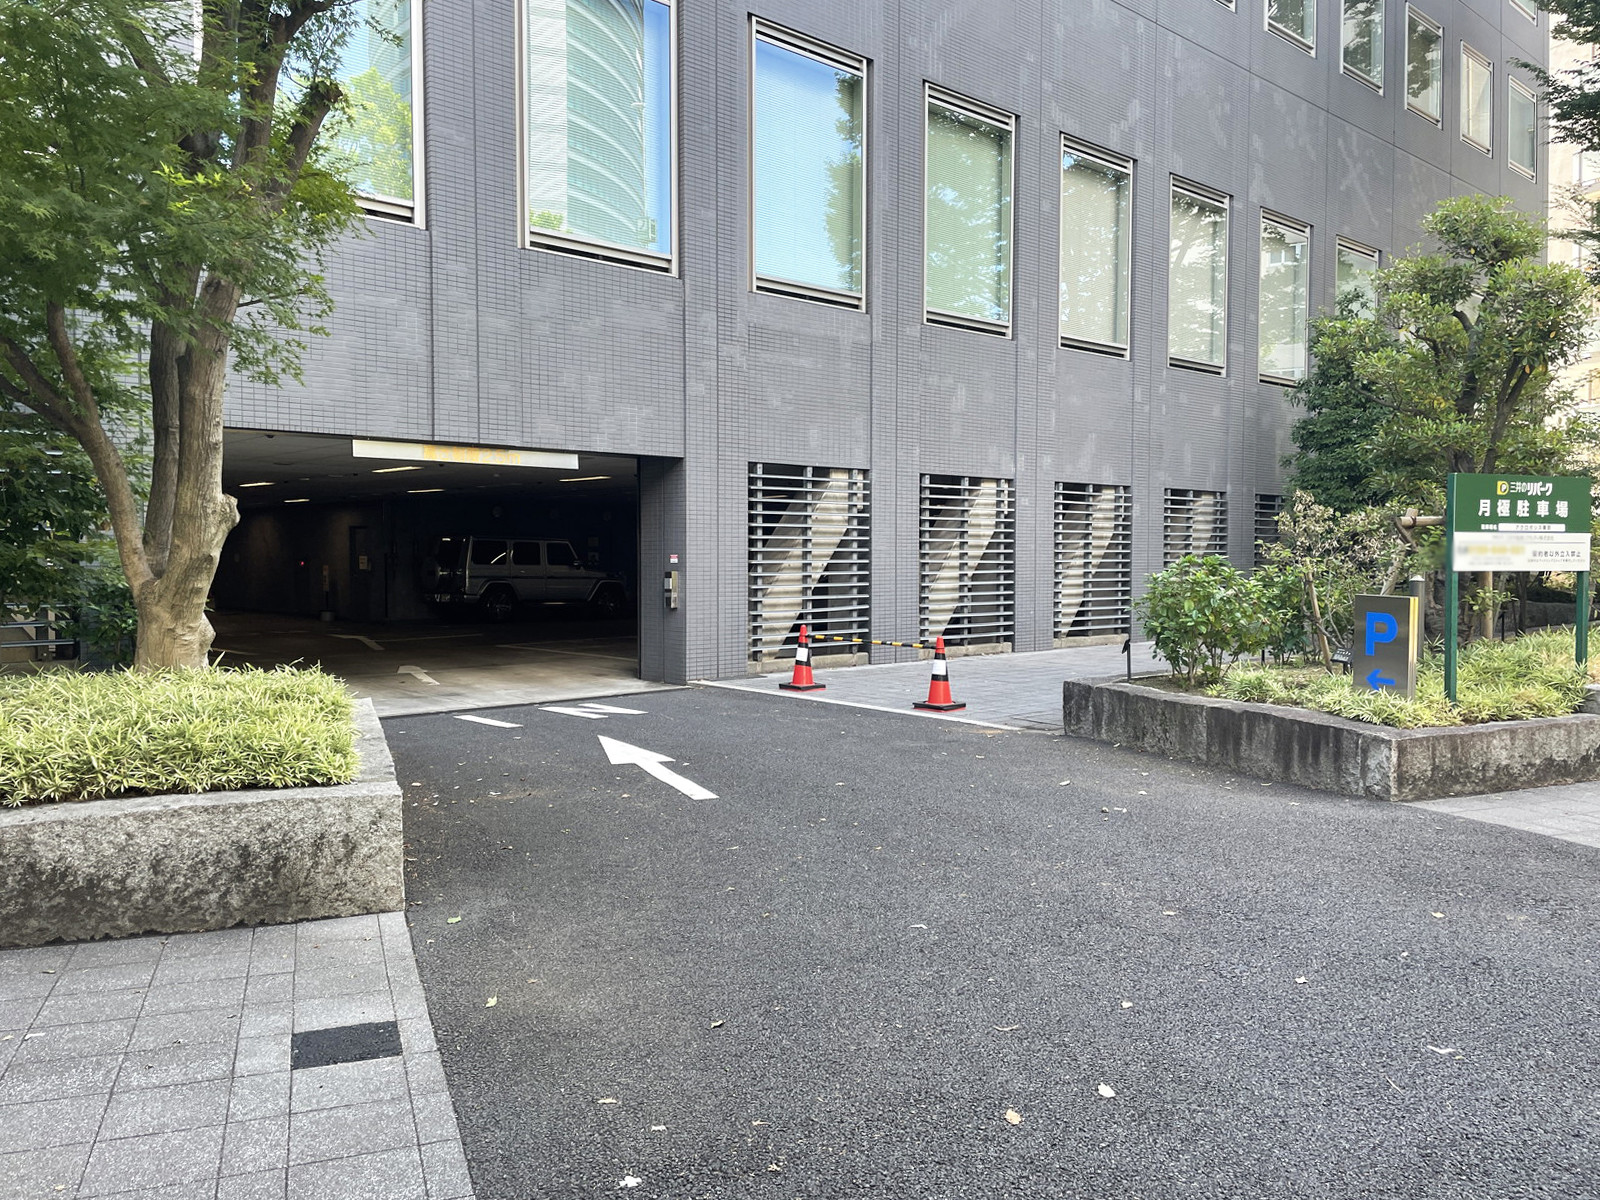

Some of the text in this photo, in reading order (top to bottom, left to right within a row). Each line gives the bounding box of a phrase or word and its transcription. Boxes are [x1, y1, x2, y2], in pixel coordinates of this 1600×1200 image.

[1510, 481, 1553, 496] 三井のリパーク
[1478, 499, 1569, 518] 月極駐車場
[1365, 611, 1398, 656] P
